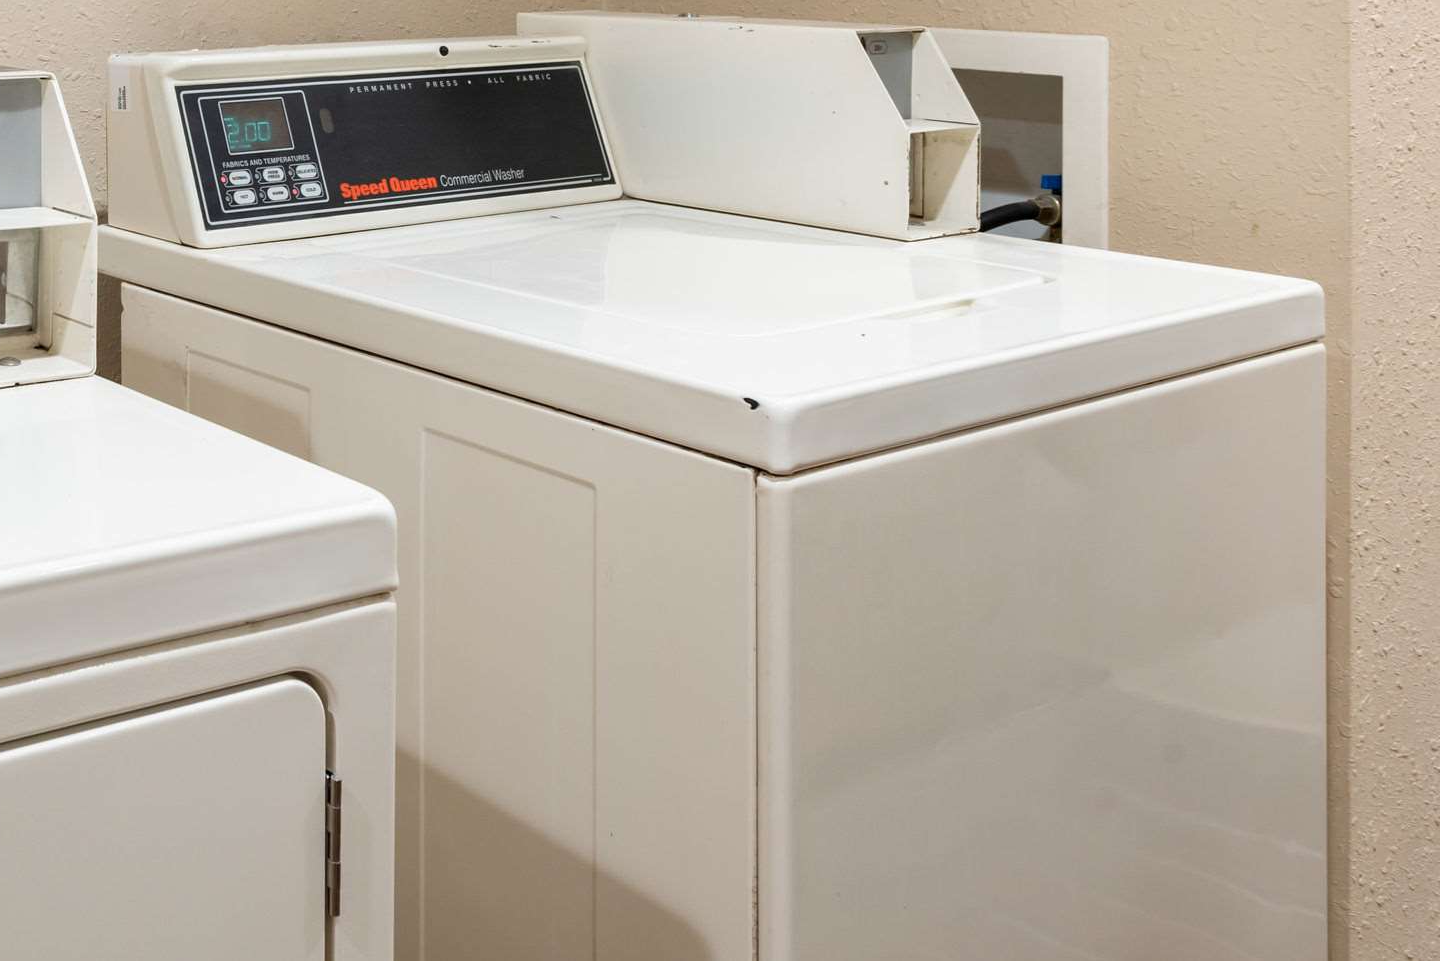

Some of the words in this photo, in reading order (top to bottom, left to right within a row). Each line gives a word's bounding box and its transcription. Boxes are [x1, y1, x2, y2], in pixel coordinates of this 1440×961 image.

[349, 82, 413, 94] PERMANENT
[426, 79, 459, 88] PRESS
[487, 76, 505, 84] ALL
[516, 73, 552, 82] FABRIC
[222, 159, 249, 169] FABRICS
[250, 158, 263, 166] AND
[264, 153, 311, 165] TEMPERATURES
[340, 179, 390, 201] Speed
[390, 174, 438, 194] Queen
[439, 170, 492, 187] Commercial
[492, 168, 526, 182] Washer
